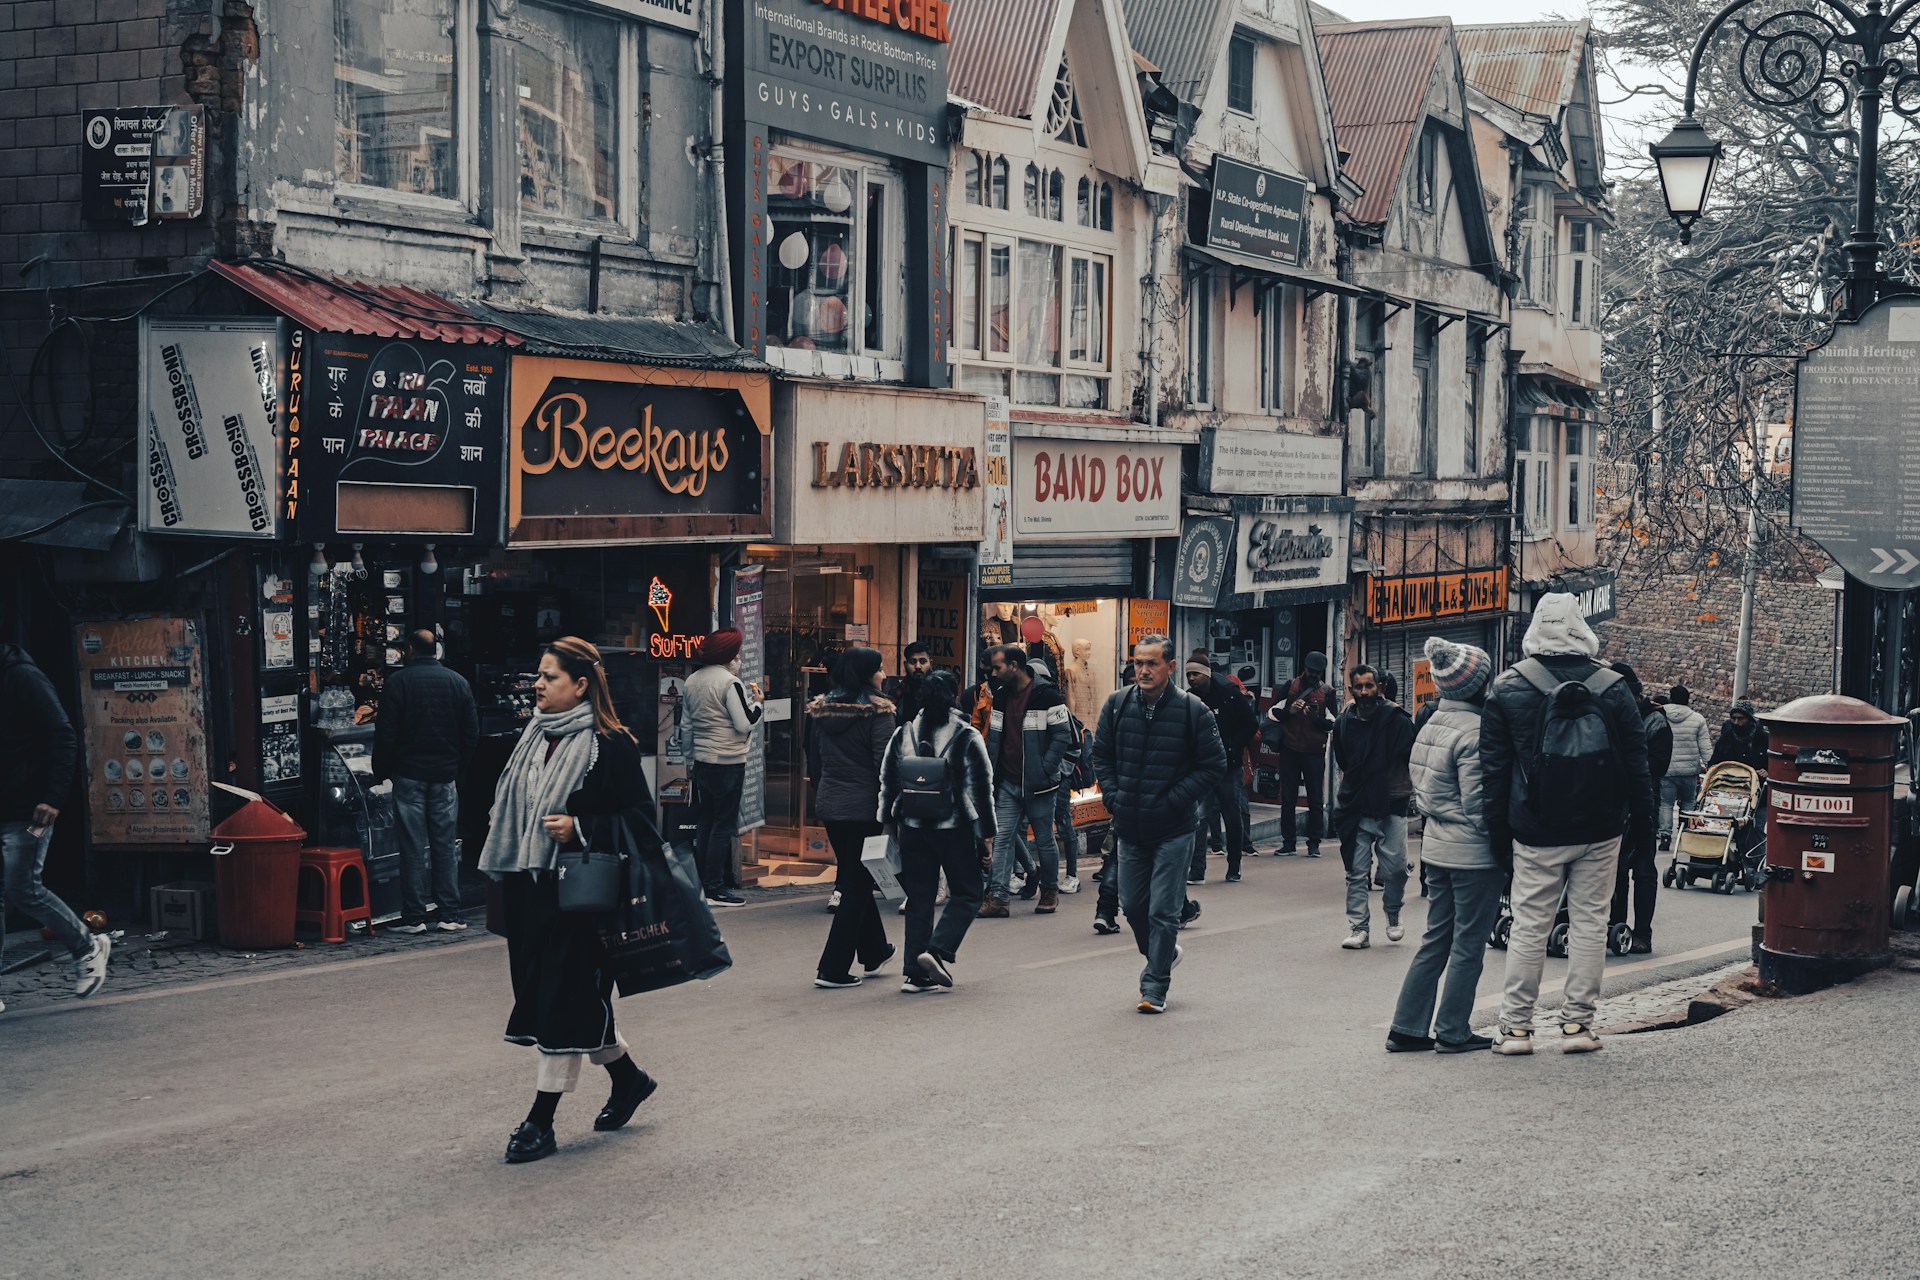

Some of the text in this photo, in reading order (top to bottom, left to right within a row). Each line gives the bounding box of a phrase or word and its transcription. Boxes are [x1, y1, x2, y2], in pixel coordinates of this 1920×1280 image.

[893, 0, 950, 43] CHEK
[755, 4, 815, 33] International
[817, 21, 848, 45] Brands
[850, 34, 859, 47] at
[861, 35, 882, 54] Rock
[884, 41, 914, 64] Bottom
[915, 51, 936, 70] Price
[769, 32, 926, 103] EXPORT SURPLUS
[114, 116, 140, 130] हिमाचल
[142, 115, 158, 130] प्रदेश
[758, 82, 936, 144] GUYS GALS KIDS
[190, 115, 198, 142] Offer
[190, 144, 197, 155] of
[752, 136, 762, 202] GUYS
[189, 177, 197, 209] Month
[1216, 188, 1299, 221] H.P. State Co-operative Agriculture
[933, 183, 941, 278] STYLE
[1220, 216, 1235, 229] Rural
[1235, 220, 1267, 238] Development
[1267, 229, 1280, 241] Bank
[1254, 212, 1260, 224] &
[751, 213, 762, 281] GALS
[751, 291, 761, 357] KIDS
[932, 289, 941, 363] CHEK
[1817, 345, 1916, 360] Shimla Heritage
[289, 330, 302, 413] GURU
[481, 365, 493, 373] 1958
[1803, 366, 1904, 374] FROM SCANDAL POINT TO
[1819, 376, 1850, 384] TOTAL
[1852, 376, 1903, 385] DISTANCE:
[161, 345, 202, 460] CROSSBOND
[322, 366, 347, 454] गुरु के पान
[358, 371, 442, 451] GRU PAAN PALACE
[460, 374, 487, 462] लबों की शान
[521, 393, 729, 497] Beekays
[1219, 446, 1228, 454] The
[1230, 446, 1239, 454] H.P.
[1240, 447, 1252, 455] State
[223, 415, 266, 531] CROSSBOND
[812, 441, 981, 488] LAKSHITA
[1034, 451, 1164, 502] BAND BOX
[287, 437, 300, 520] PAAN
[981, 575, 1011, 584] FAMILY STORE
[982, 565, 1010, 575] A COMPLETE
[919, 580, 952, 601] NEW
[1450, 588, 1458, 609] &
[919, 608, 958, 629] TYLE
[1131, 626, 1166, 635] SPECIAL
[1277, 637, 1291, 652] hp
[111, 656, 168, 667] KITCHEN
[94, 671, 130, 681] BREAKFAST
[134, 670, 156, 679] LUNCH
[111, 715, 177, 726] Packing also Available
[1795, 797, 1851, 811] 171001
[153, 825, 181, 833] Business
[639, 920, 670, 940] CHEK
